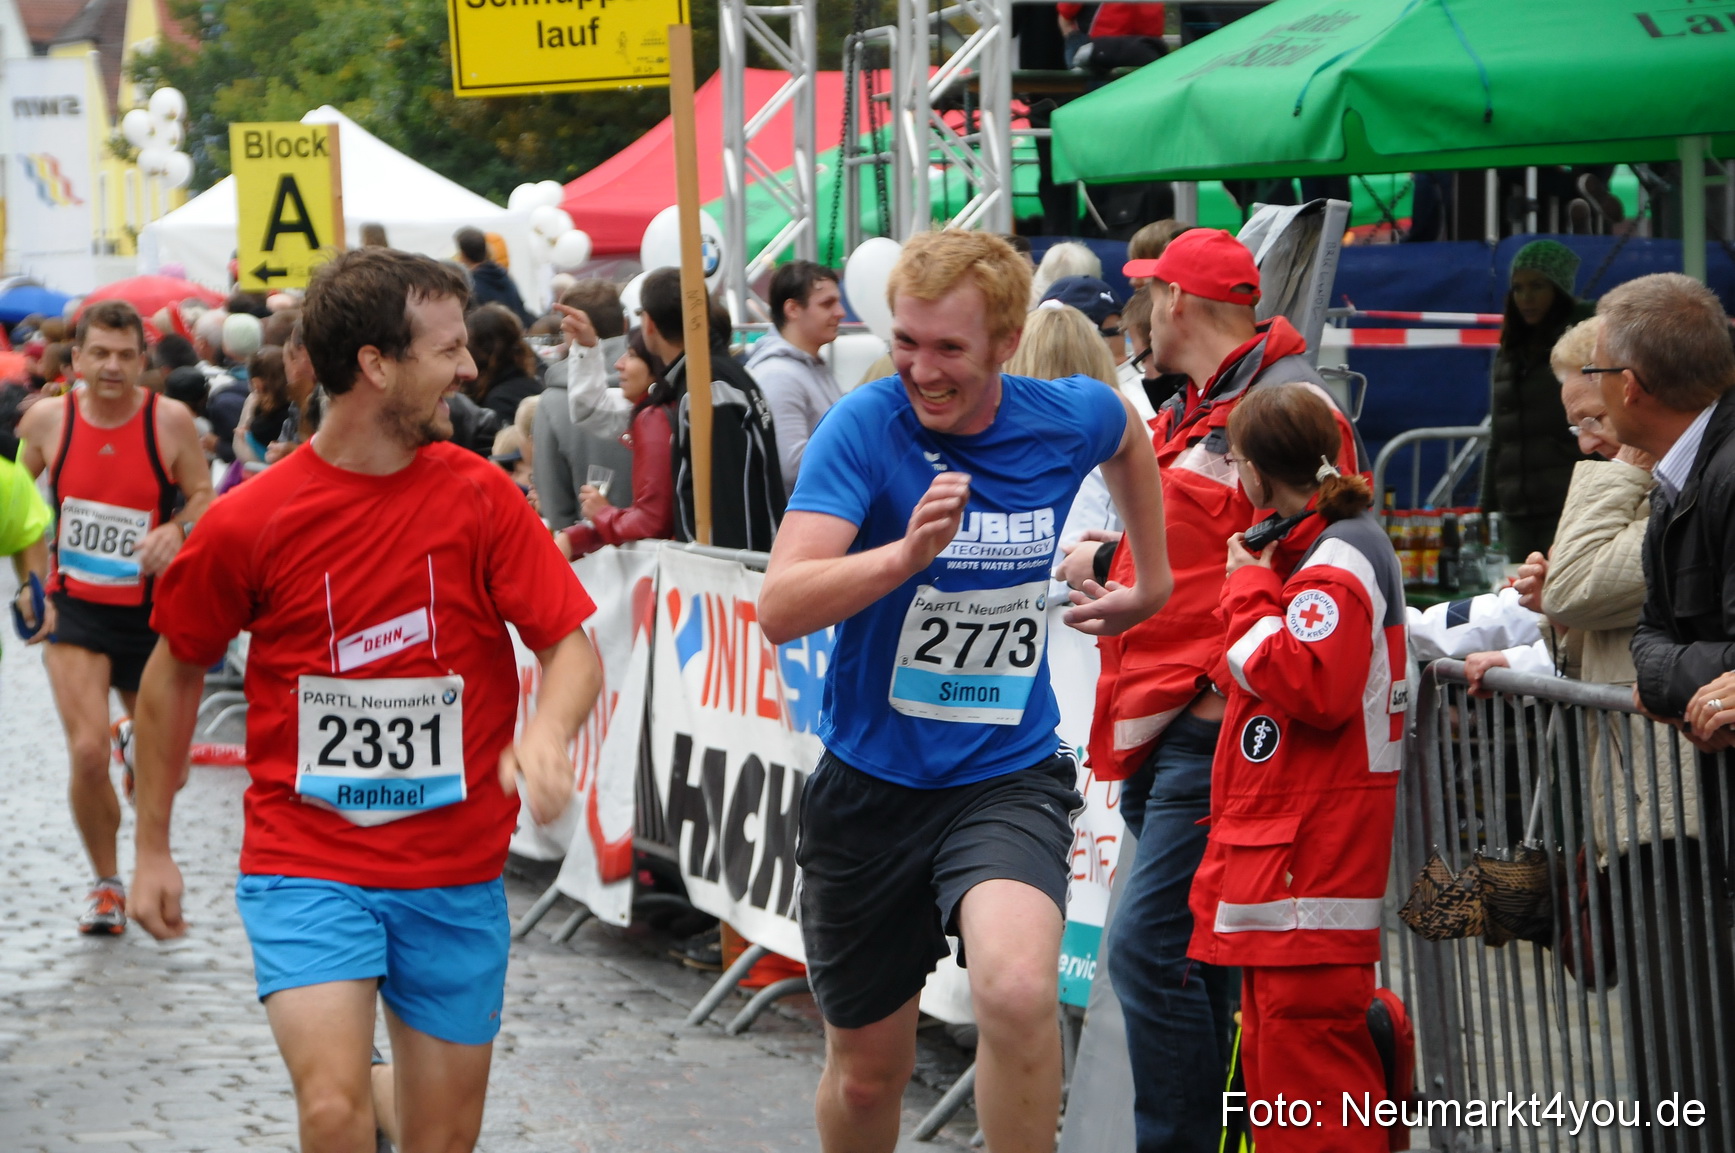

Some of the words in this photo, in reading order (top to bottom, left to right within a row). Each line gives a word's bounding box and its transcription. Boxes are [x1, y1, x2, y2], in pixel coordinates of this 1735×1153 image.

[536, 16, 600, 48] lauf
[1633, 11, 1735, 38] La
[244, 130, 330, 159] Block
[261, 173, 320, 252] A
[68, 518, 137, 557] 3086
[952, 507, 1055, 543] UBER
[950, 541, 1051, 557] TECHNOLOGY
[946, 561, 979, 570] WASTE
[981, 561, 1015, 571] WATER
[914, 597, 963, 613] PARTL
[968, 599, 1029, 616] Neumarkt
[1294, 593, 1334, 616] DEUTSCHES
[1290, 613, 1305, 637] ROTES
[1306, 621, 1332, 638] KREUZ
[364, 626, 402, 653] DEHN
[914, 617, 1037, 669] 2773
[303, 691, 357, 708] PARTL
[361, 694, 436, 710] Neumarkt
[939, 682, 1000, 703] Simon
[317, 713, 441, 770] 2331
[337, 784, 425, 809] Raphael
[1058, 952, 1097, 981] ervic
